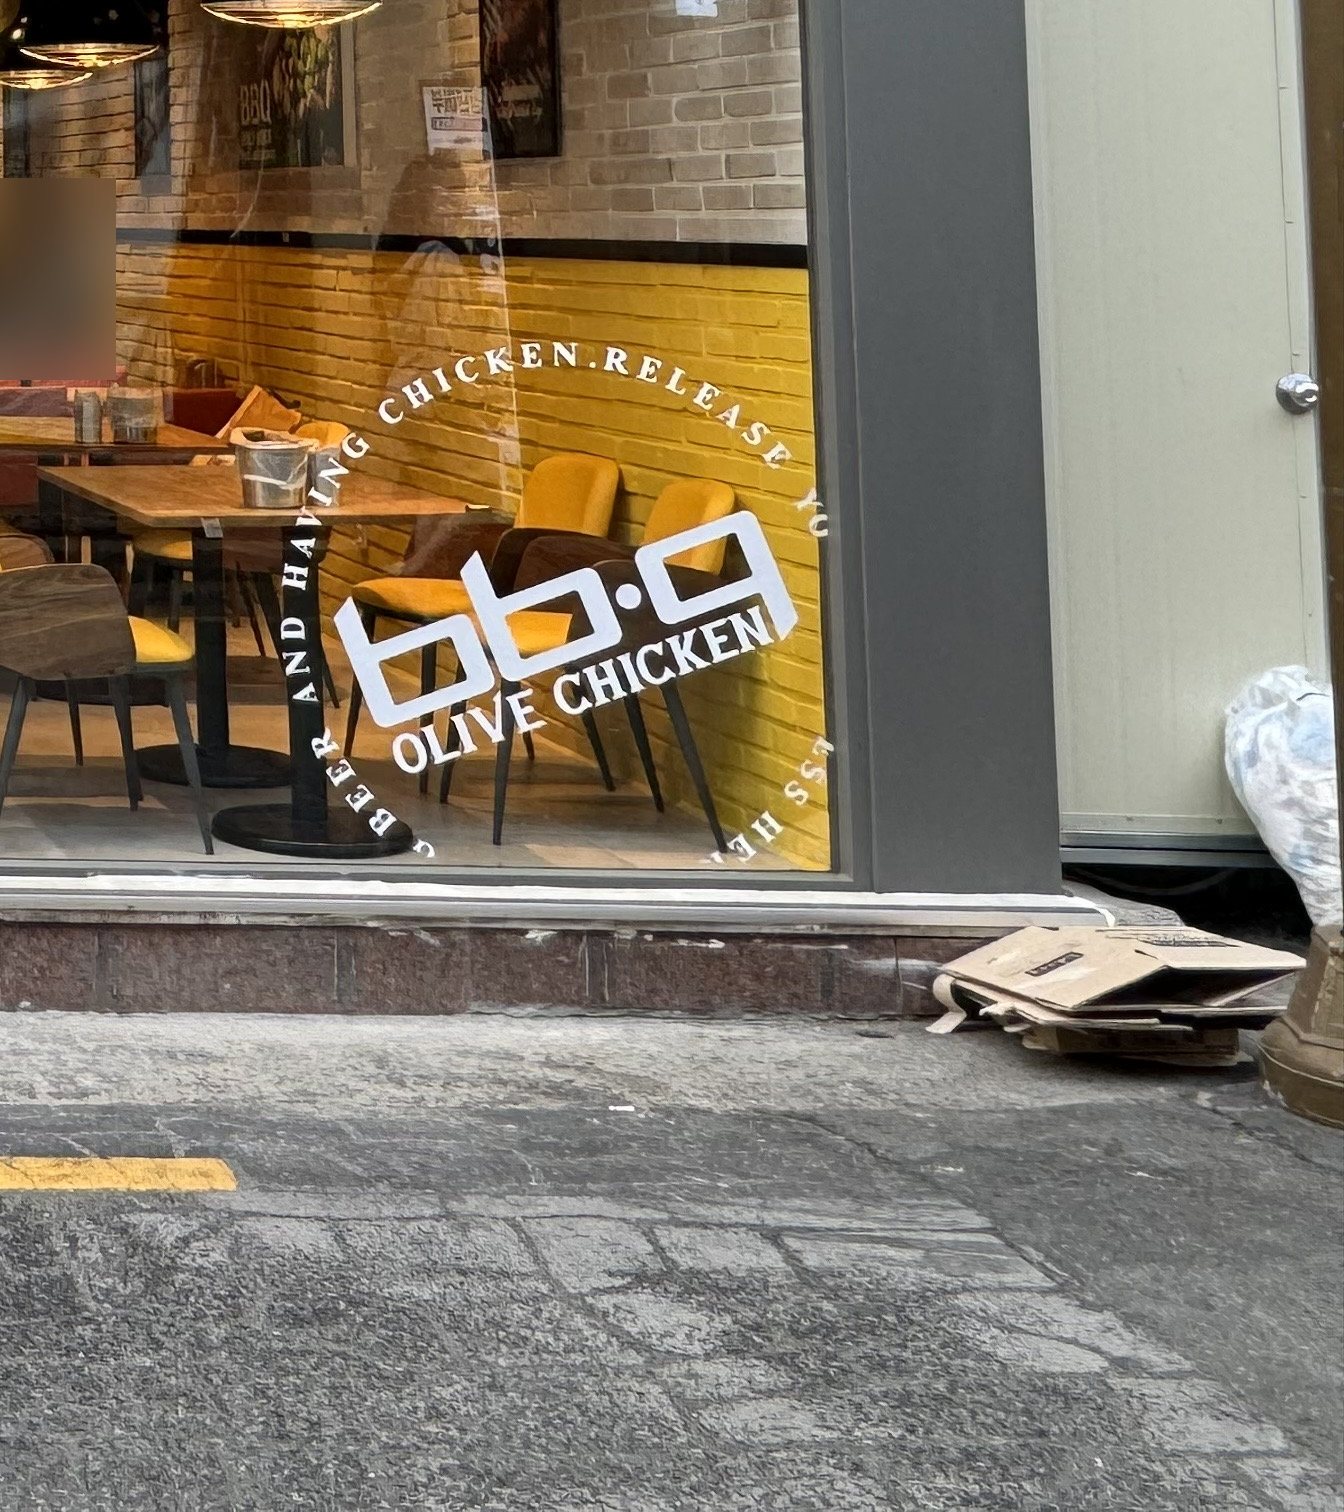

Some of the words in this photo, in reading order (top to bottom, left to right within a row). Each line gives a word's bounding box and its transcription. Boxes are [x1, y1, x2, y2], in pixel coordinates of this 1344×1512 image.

[281, 432, 371, 591] HAVING
[281, 616, 320, 703] AND
[391, 688, 547, 775] OLIVE
[552, 604, 782, 716] CHICKEN
[311, 727, 397, 837] BEER
